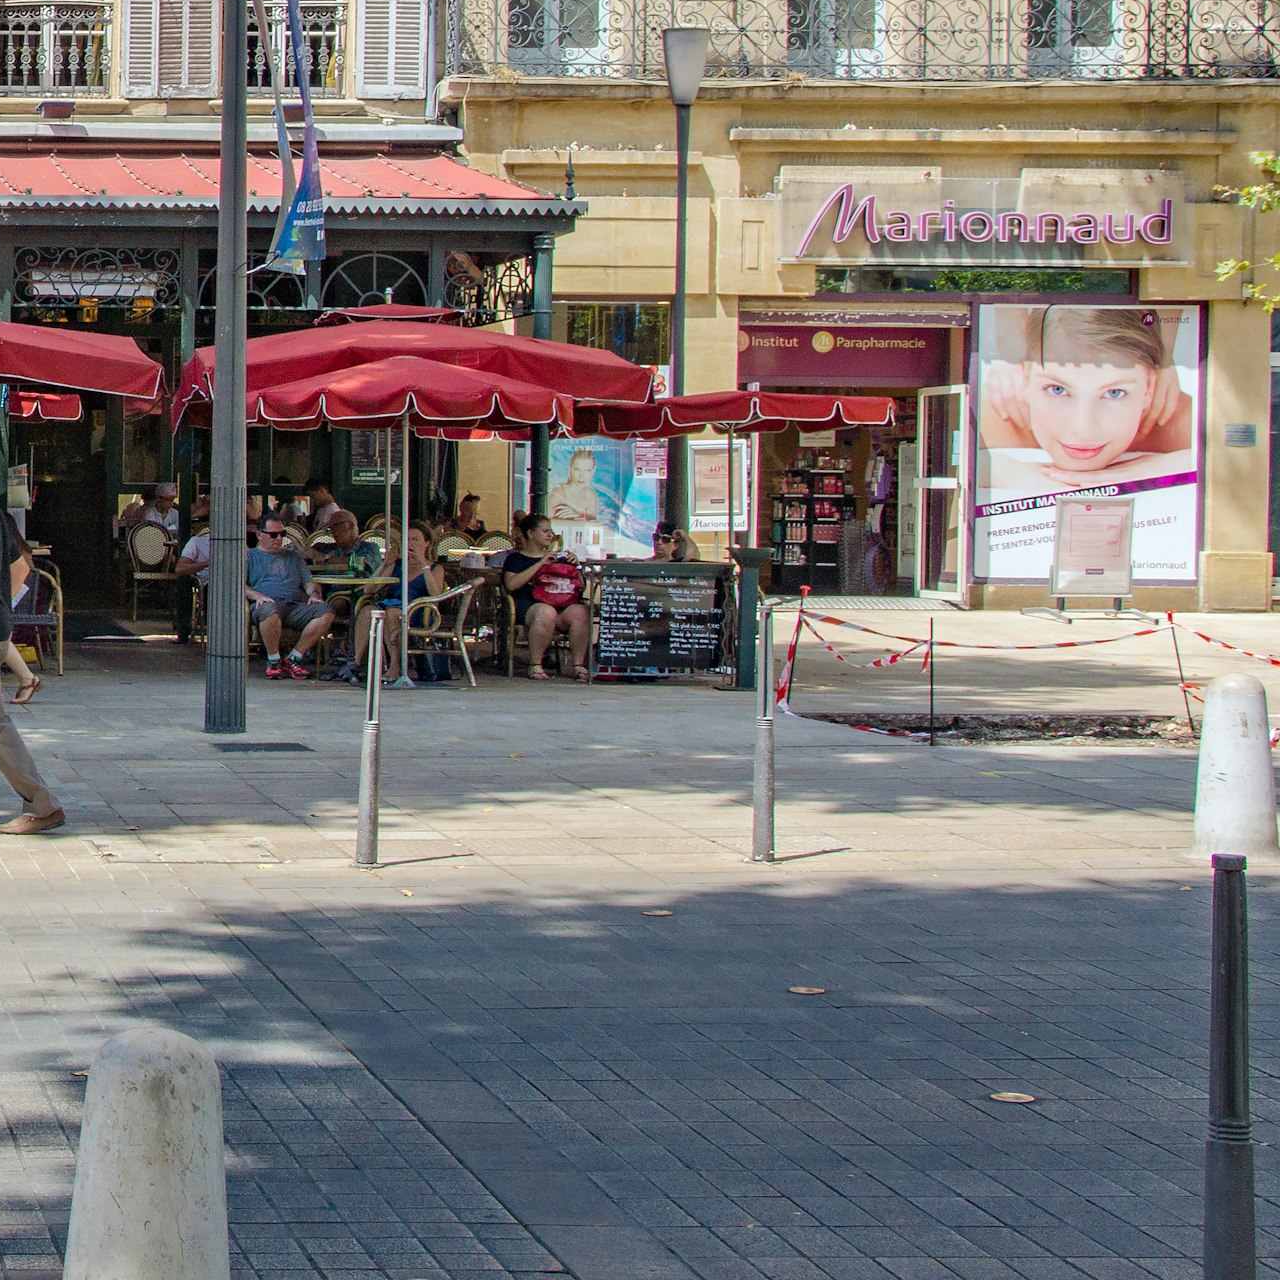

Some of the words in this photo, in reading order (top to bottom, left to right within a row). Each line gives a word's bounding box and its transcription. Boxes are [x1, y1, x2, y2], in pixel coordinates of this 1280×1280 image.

[796, 183, 1173, 258] Marionnaud
[751, 336, 799, 347] Institut
[836, 336, 926, 350] Parapharmacie
[982, 498, 1035, 516] INSTITUT
[1036, 485, 1120, 508] MANNAUD
[690, 518, 745, 528] Marionnud
[987, 527, 1020, 538] PRENEZ
[1147, 517, 1171, 526] BELLE
[989, 544, 1000, 552] ET
